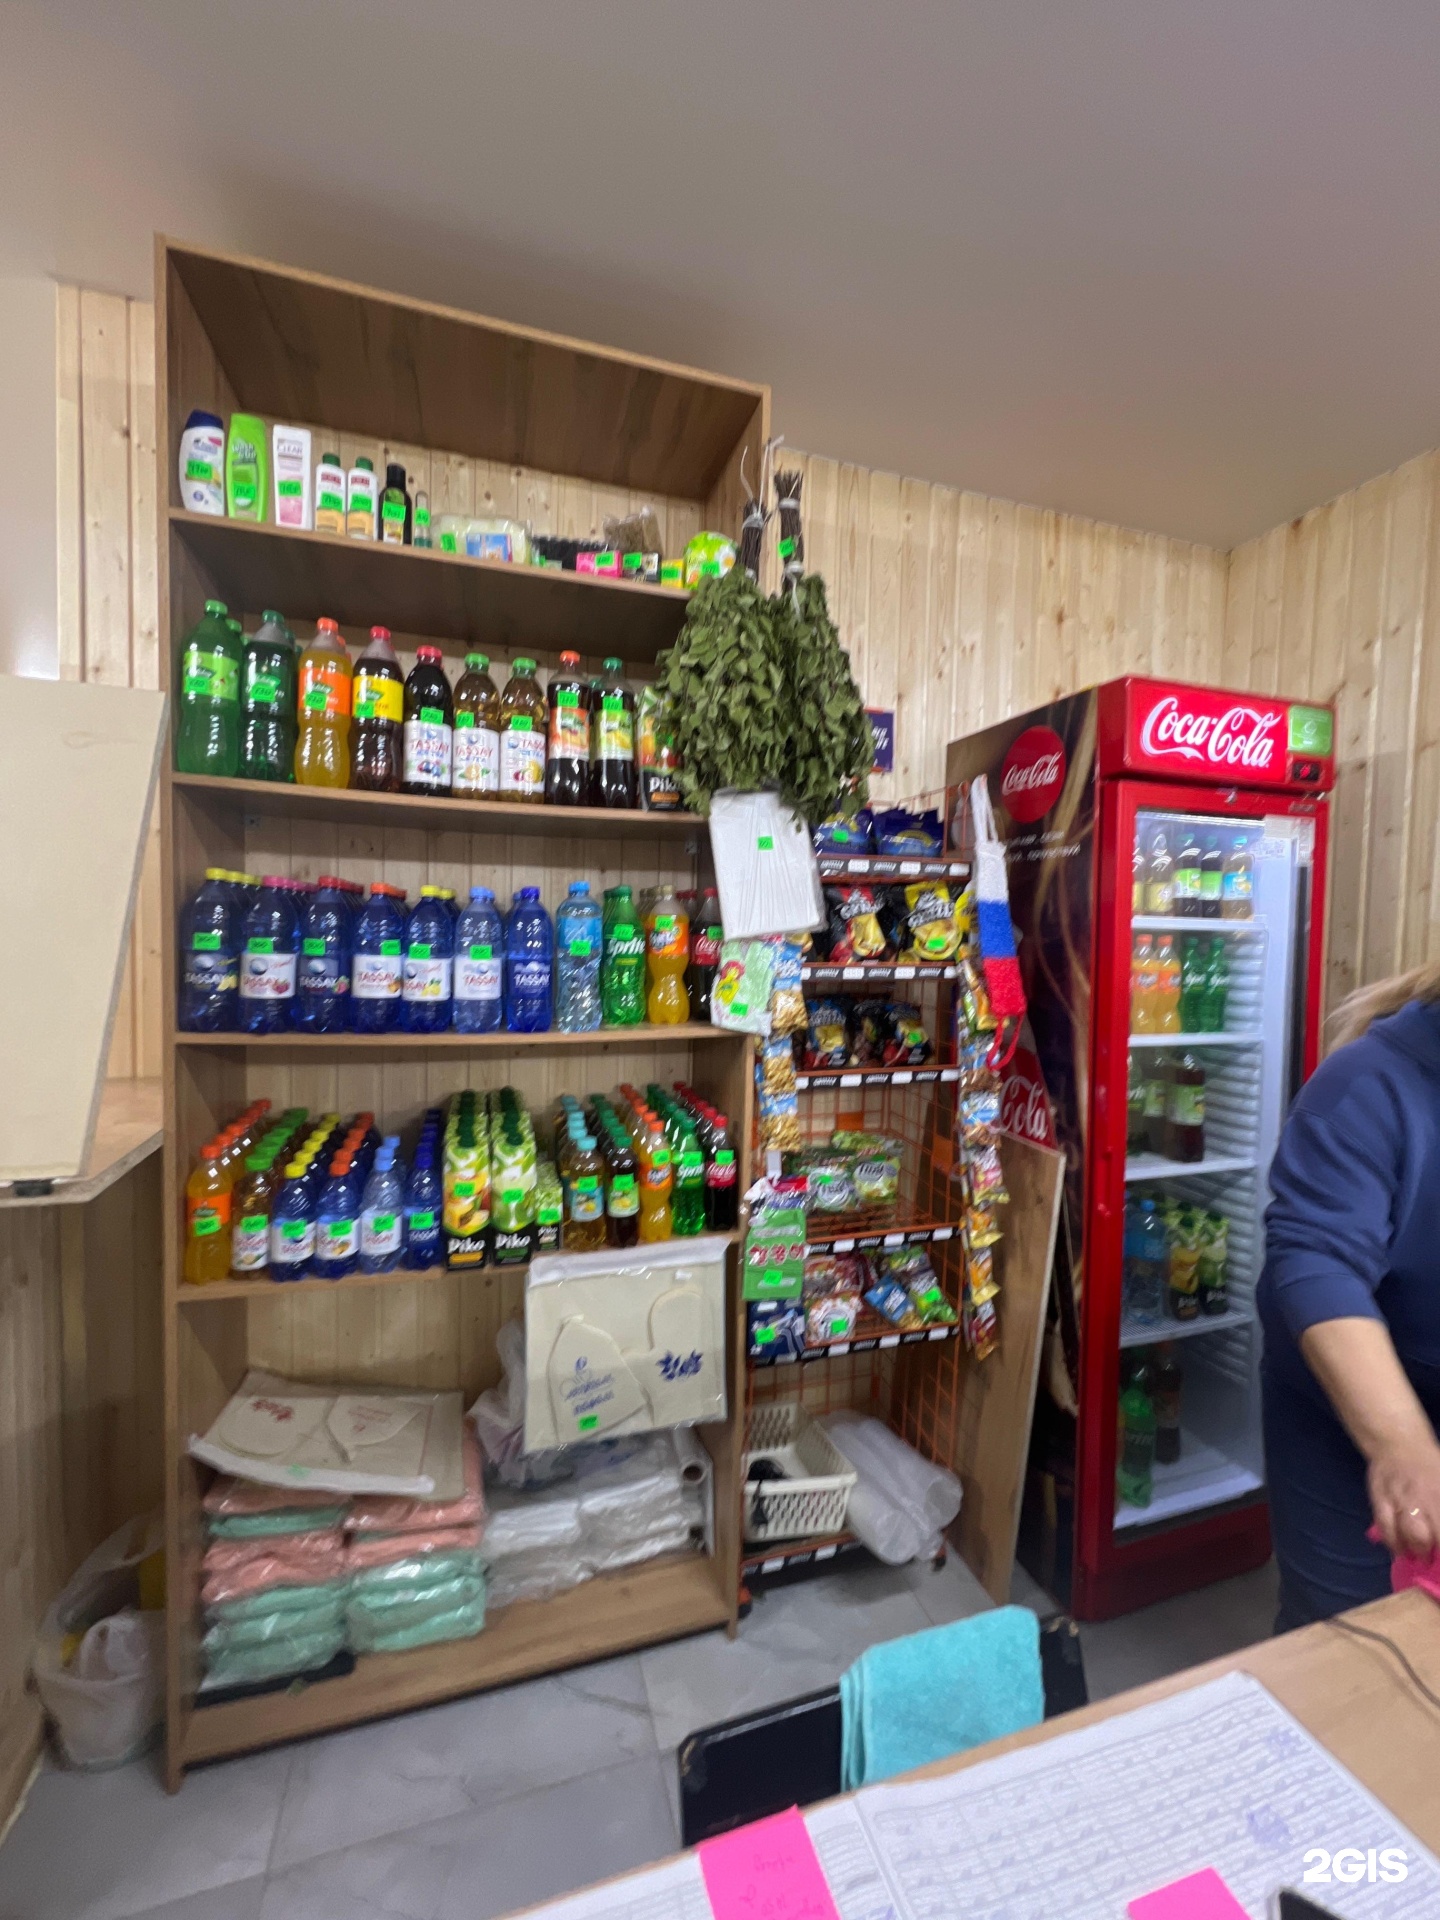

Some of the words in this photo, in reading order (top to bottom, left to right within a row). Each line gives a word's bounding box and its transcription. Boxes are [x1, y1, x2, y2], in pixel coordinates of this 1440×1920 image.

[1140, 696, 1282, 768] Coca-Cola
[410, 738, 450, 754] TASSAY
[455, 745, 494, 758] TASSAY
[1002, 752, 1063, 796] Coca-Cola
[357, 972, 395, 983] TASSAY
[463, 974, 499, 986] TASSAY
[514, 973, 550, 986] TASSAY
[447, 1237, 485, 1254] Piko
[494, 1233, 531, 1249] Piko
